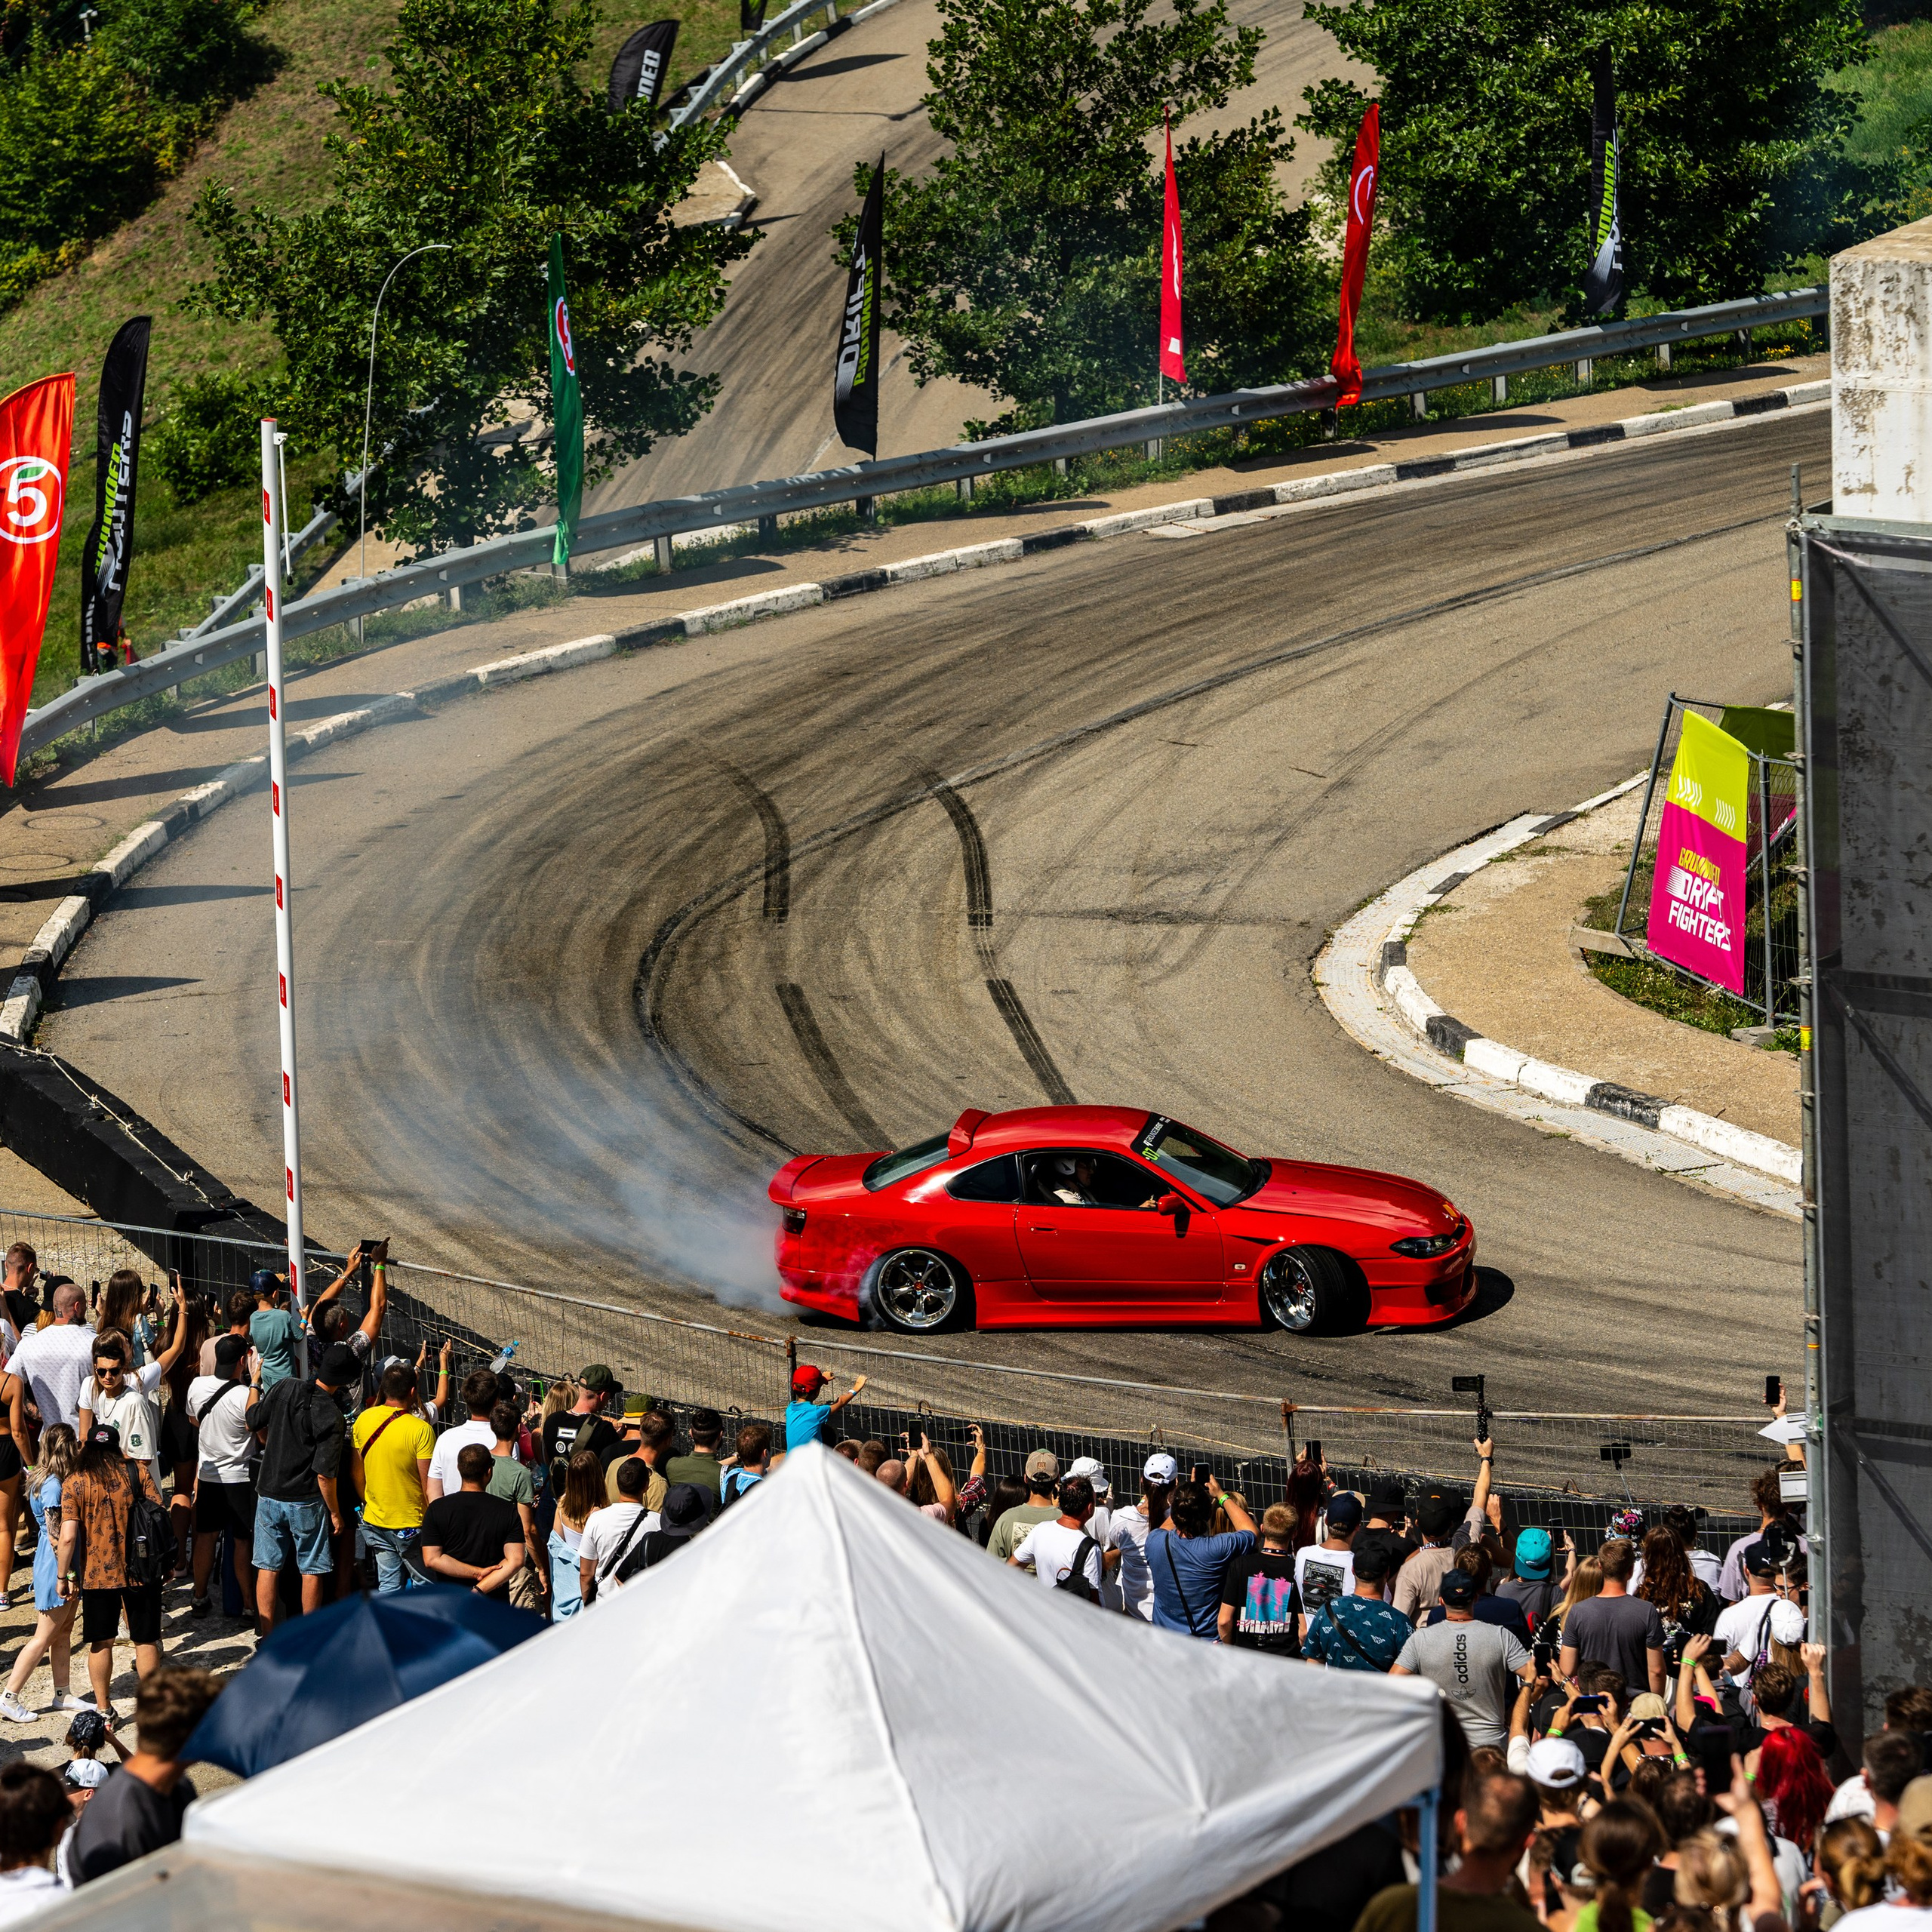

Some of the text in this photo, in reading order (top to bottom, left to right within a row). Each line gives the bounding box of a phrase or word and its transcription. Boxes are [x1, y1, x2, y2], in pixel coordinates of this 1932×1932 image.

[6, 462, 48, 527] 5
[1668, 866, 1724, 918] DRIFT
[1668, 900, 1732, 952] FIGHTERS
[1453, 1633, 1469, 1684] adidas
